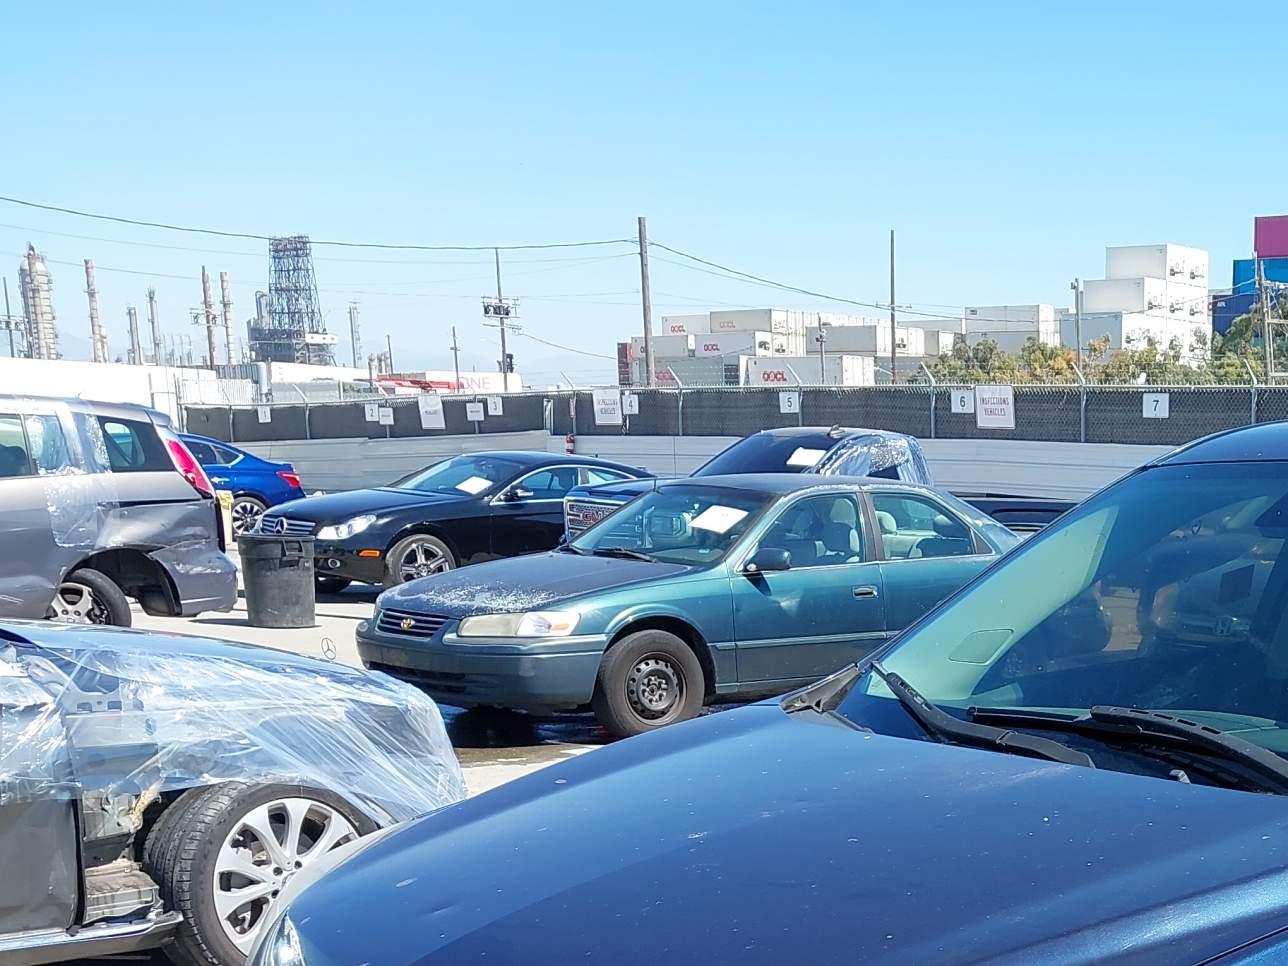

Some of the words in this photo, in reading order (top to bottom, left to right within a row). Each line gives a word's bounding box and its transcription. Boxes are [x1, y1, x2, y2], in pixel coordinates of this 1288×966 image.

[703, 343, 721, 352] OOCL
[762, 370, 788, 382] OOCL
[628, 400, 633, 410] 4
[787, 396, 793, 408] 5
[959, 395, 966, 408] 6
[1152, 399, 1160, 412] 7
[370, 407, 374, 417] 2
[582, 510, 604, 523] GM
